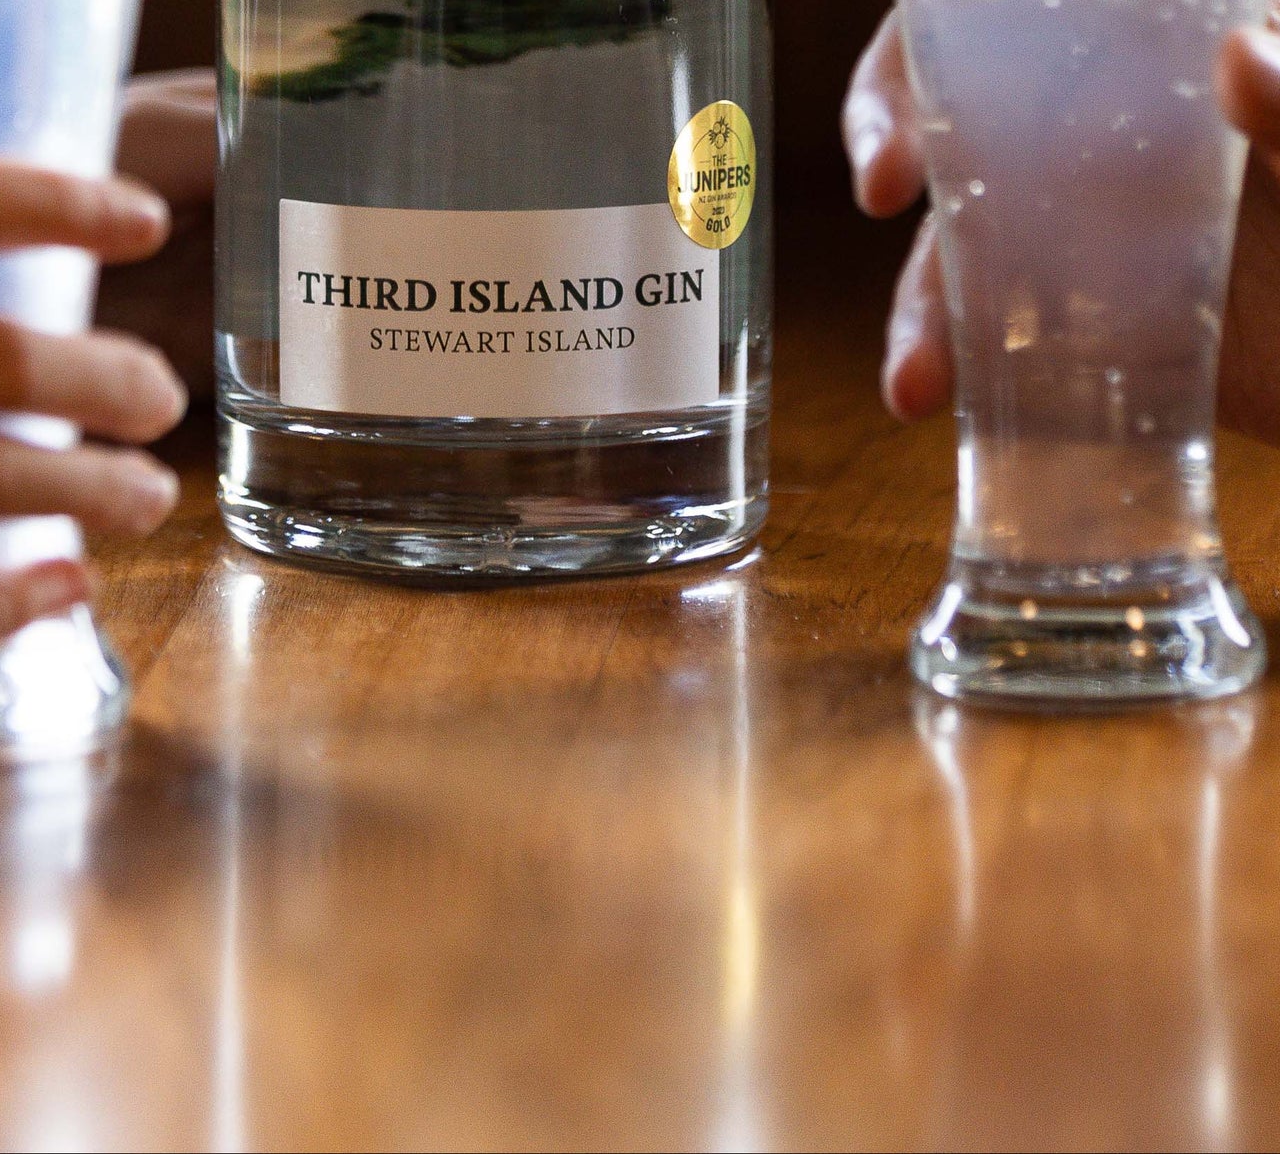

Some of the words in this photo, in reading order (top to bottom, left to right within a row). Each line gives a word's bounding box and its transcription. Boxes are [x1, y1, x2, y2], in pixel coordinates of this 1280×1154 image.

[712, 153, 727, 167] THE
[677, 164, 750, 193] JUNIPERS
[706, 216, 730, 233] GOLD
[296, 270, 438, 313] THIRD
[449, 277, 626, 314] ISLAND
[635, 268, 706, 307] GIN
[369, 327, 516, 354] STEWART
[525, 326, 636, 354] ISLAND
